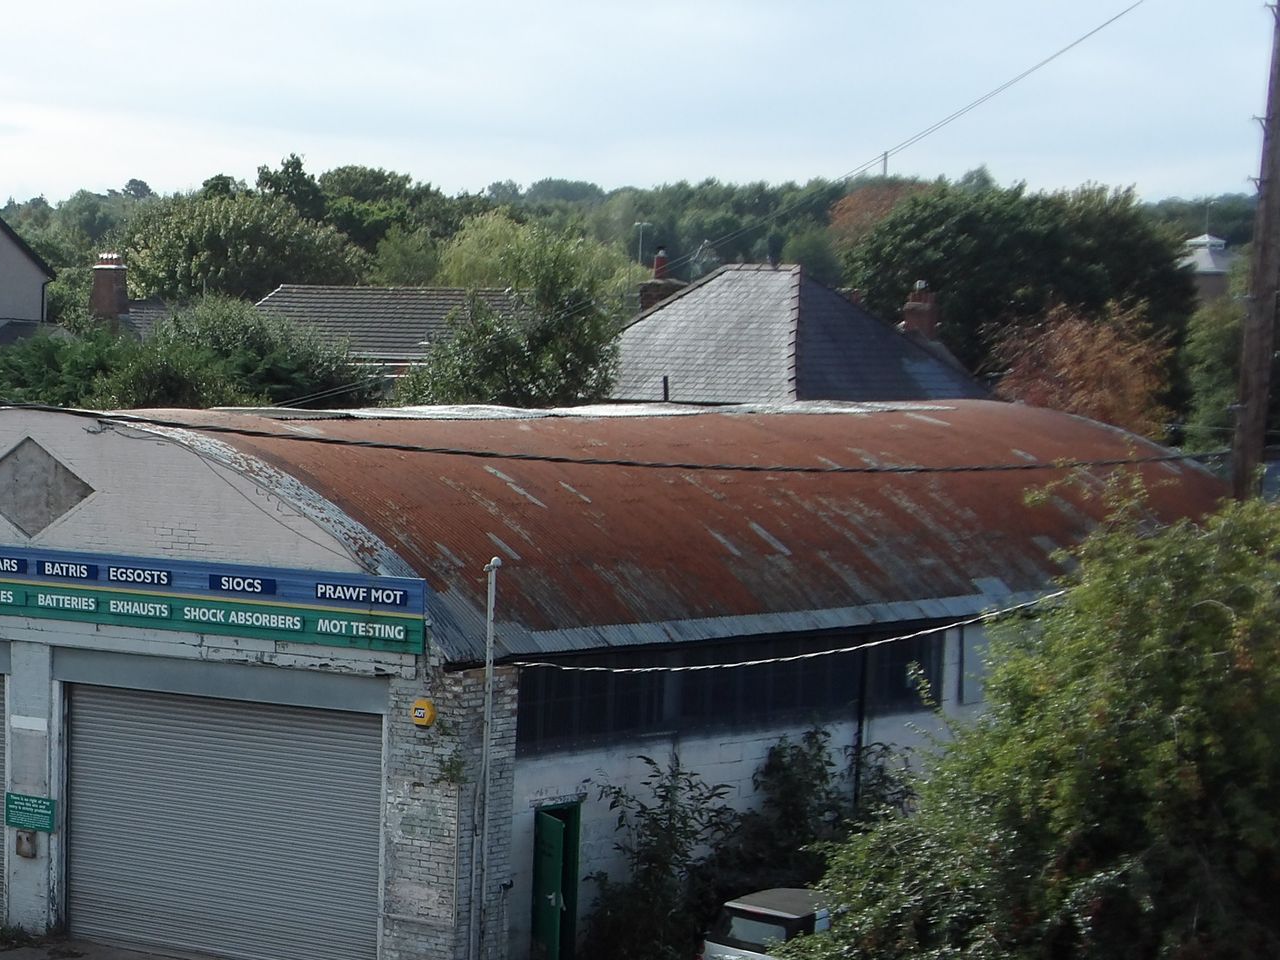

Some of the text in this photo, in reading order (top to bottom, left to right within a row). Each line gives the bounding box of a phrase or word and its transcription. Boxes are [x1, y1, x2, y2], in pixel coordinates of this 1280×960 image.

[44, 562, 88, 578] BATRIS
[109, 567, 168, 585] EGSOSTS
[221, 577, 262, 593] SIOCS
[37, 593, 96, 610] BATTERIES
[317, 584, 404, 604] PRAWF MOT
[109, 600, 168, 617] EXHAUSTS
[183, 606, 301, 629] SHOCK ABSORBERS
[317, 619, 404, 639] MOT TESTING
